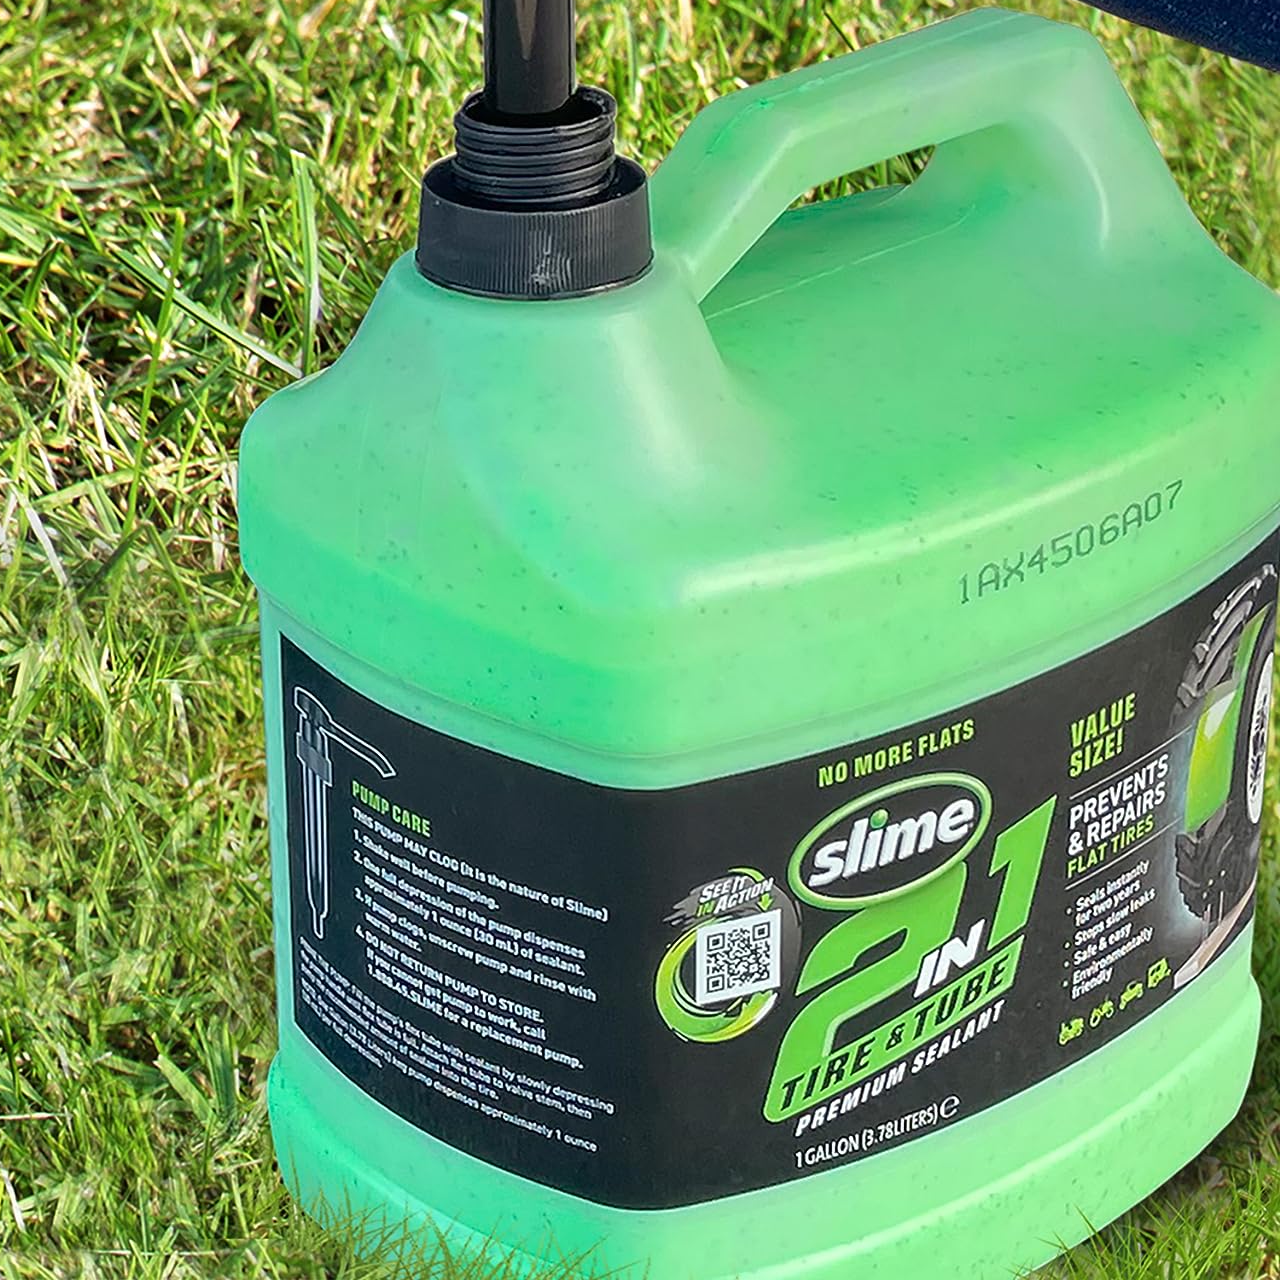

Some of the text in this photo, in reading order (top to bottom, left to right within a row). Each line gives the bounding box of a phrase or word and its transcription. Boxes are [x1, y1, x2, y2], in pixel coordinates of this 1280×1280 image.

[958, 479, 1183, 605] 1AX4506A07
[1070, 692, 1136, 749] VALUE
[817, 718, 976, 788] NO MORE FLATS
[1069, 727, 1124, 778] SIZE!
[351, 780, 431, 838] PUMP CARE
[1067, 781, 1166, 856] & REPAIRS
[1069, 753, 1169, 830] PREVENTS
[352, 806, 374, 830] THIS
[373, 821, 403, 843] PUMP
[403, 837, 428, 858] MAY
[428, 849, 459, 872] CLOG
[487, 873, 507, 890] the
[508, 882, 549, 905] nature
[550, 895, 565, 909] of
[565, 898, 608, 922] Slime)
[807, 797, 975, 887] slime
[1067, 814, 1154, 879] FLAT TIRES
[411, 863, 445, 888] before
[446, 881, 500, 910] pumping.
[696, 876, 775, 918] IN ACTION
[699, 875, 746, 903] SEE IT
[913, 919, 986, 999] IN
[987, 793, 1059, 952] 1
[1074, 888, 1156, 946] Stops slow leaks
[1075, 860, 1150, 912] Seals instantly
[1075, 909, 1093, 927] for
[1113, 880, 1141, 907] years
[398, 879, 454, 914] depression
[455, 906, 467, 919] of
[467, 910, 487, 927] the
[488, 919, 522, 940] pump
[523, 931, 586, 960] dispenses
[439, 916, 473, 938] ounce
[495, 938, 519, 956] mL)
[520, 948, 534, 960] of
[534, 952, 586, 976] sealant.
[1073, 923, 1133, 966] Safe & easy
[380, 940, 400, 961] NOT
[400, 951, 444, 984] RETURN
[444, 974, 480, 999] PUMP
[480, 989, 498, 1007] TO
[498, 998, 545, 1024] STORE.
[428, 932, 475, 960] unscrew
[474, 952, 508, 974] pump
[508, 965, 532, 982] and
[533, 973, 566, 993] rinse
[567, 983, 597, 1002] with
[1071, 966, 1114, 1000] friendly
[1072, 927, 1154, 985] Environmentally
[391, 965, 424, 990] cannot
[442, 991, 473, 1014] pump
[473, 1005, 487, 1019] to
[487, 1011, 522, 1034] work,
[523, 1024, 547, 1041] call
[780, 952, 1011, 1112] TIRE & TUBE
[443, 1006, 461, 1024] for
[460, 1017, 470, 1029] a
[469, 1019, 544, 1057] replacement
[543, 1048, 585, 1070] pump.
[794, 999, 1006, 1137] PREMIUM SEALANT
[464, 1052, 501, 1075] sealant
[501, 1066, 516, 1082] by
[516, 1074, 552, 1095] slowly
[551, 1085, 616, 1116] depressing
[504, 1082, 534, 1101] valve
[566, 1104, 593, 1120] then
[480, 1103, 554, 1139] approximately
[563, 1135, 598, 1153] ounce
[804, 1132, 860, 1166] GALLON
